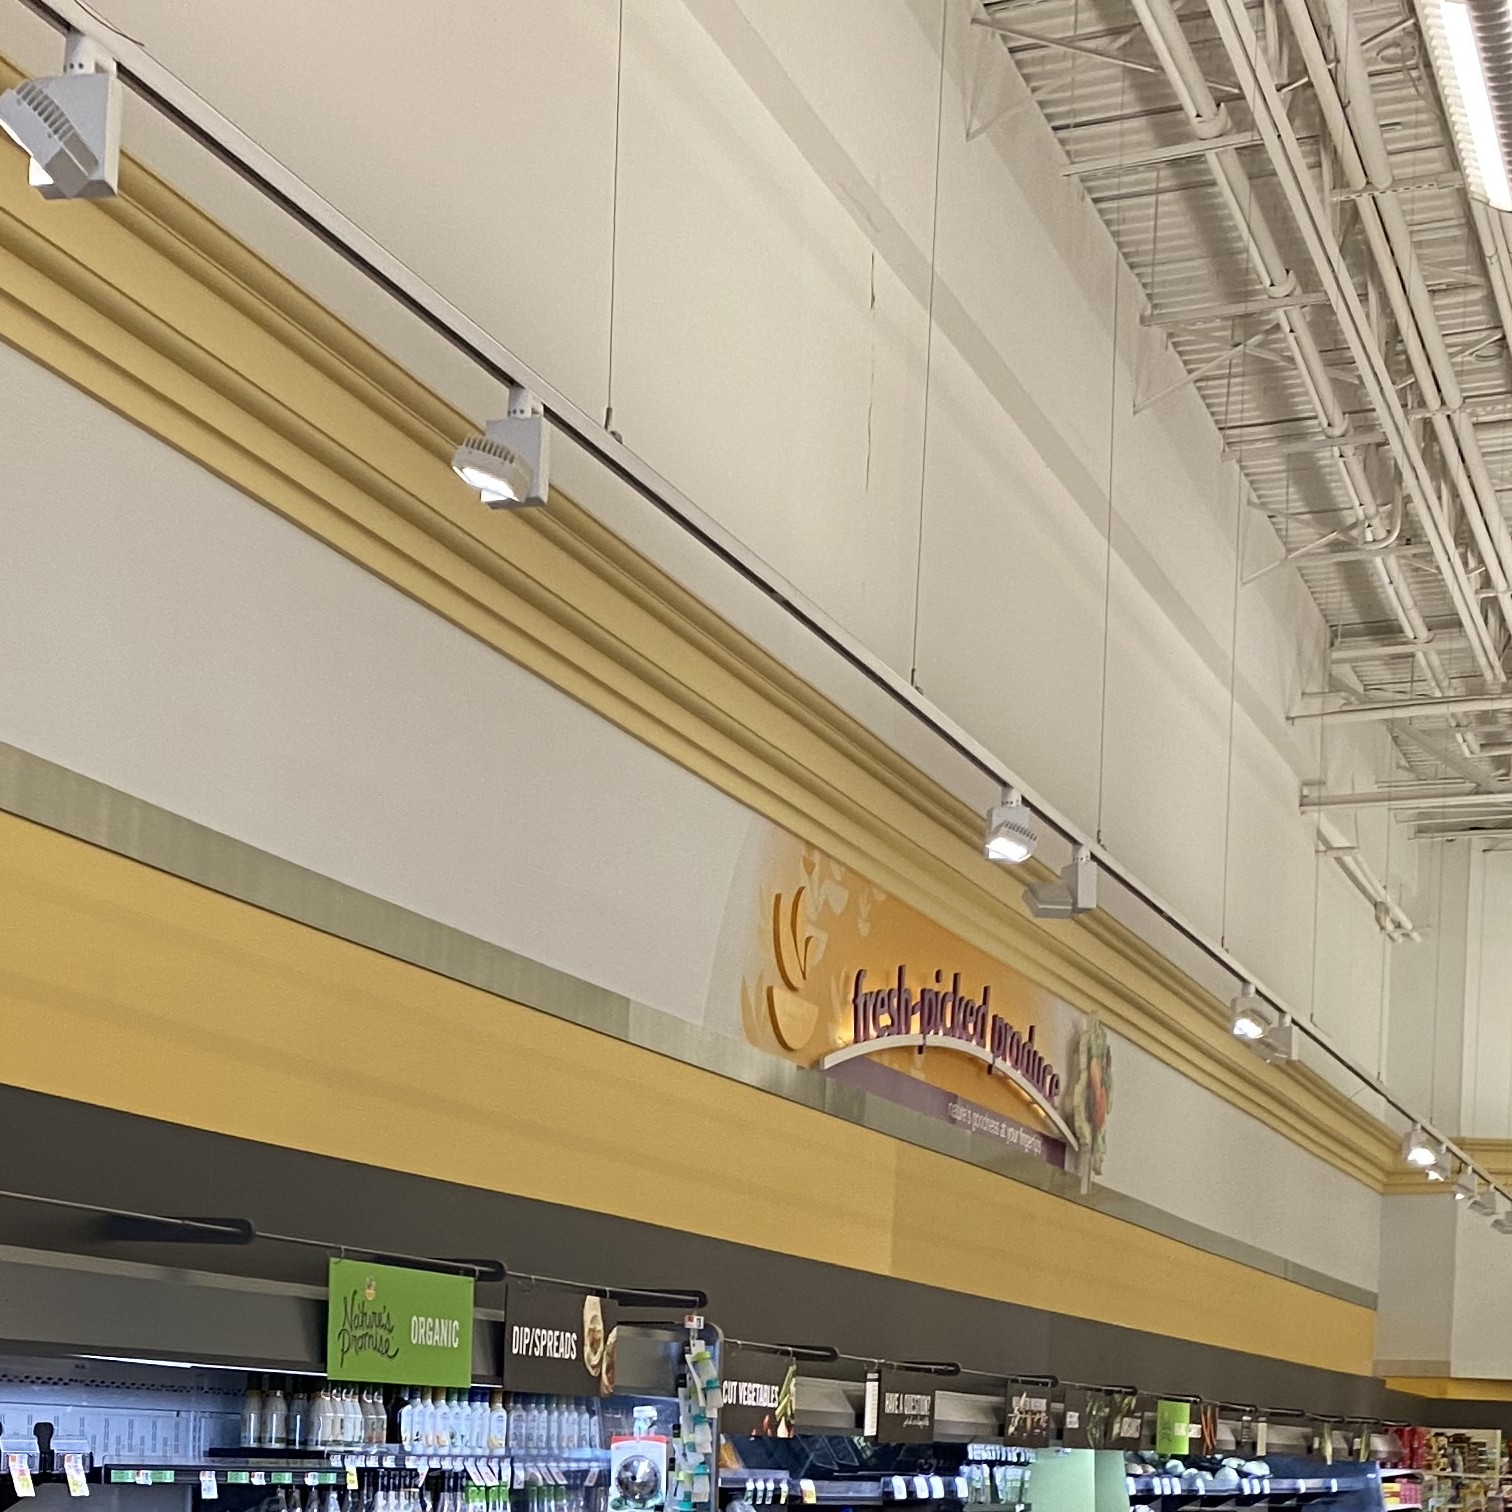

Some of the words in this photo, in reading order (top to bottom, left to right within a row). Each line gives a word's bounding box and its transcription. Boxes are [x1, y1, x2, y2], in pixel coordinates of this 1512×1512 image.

[853, 965, 990, 1054] fresh-picked
[988, 1013, 1061, 1098] produce
[342, 1290, 394, 1334] Nature's
[411, 1315, 460, 1348] ORGANIC
[512, 1325, 577, 1360] DIP/SPREADS
[722, 1380, 738, 1404] CUT
[738, 1382, 779, 1408] VEGETABLES
